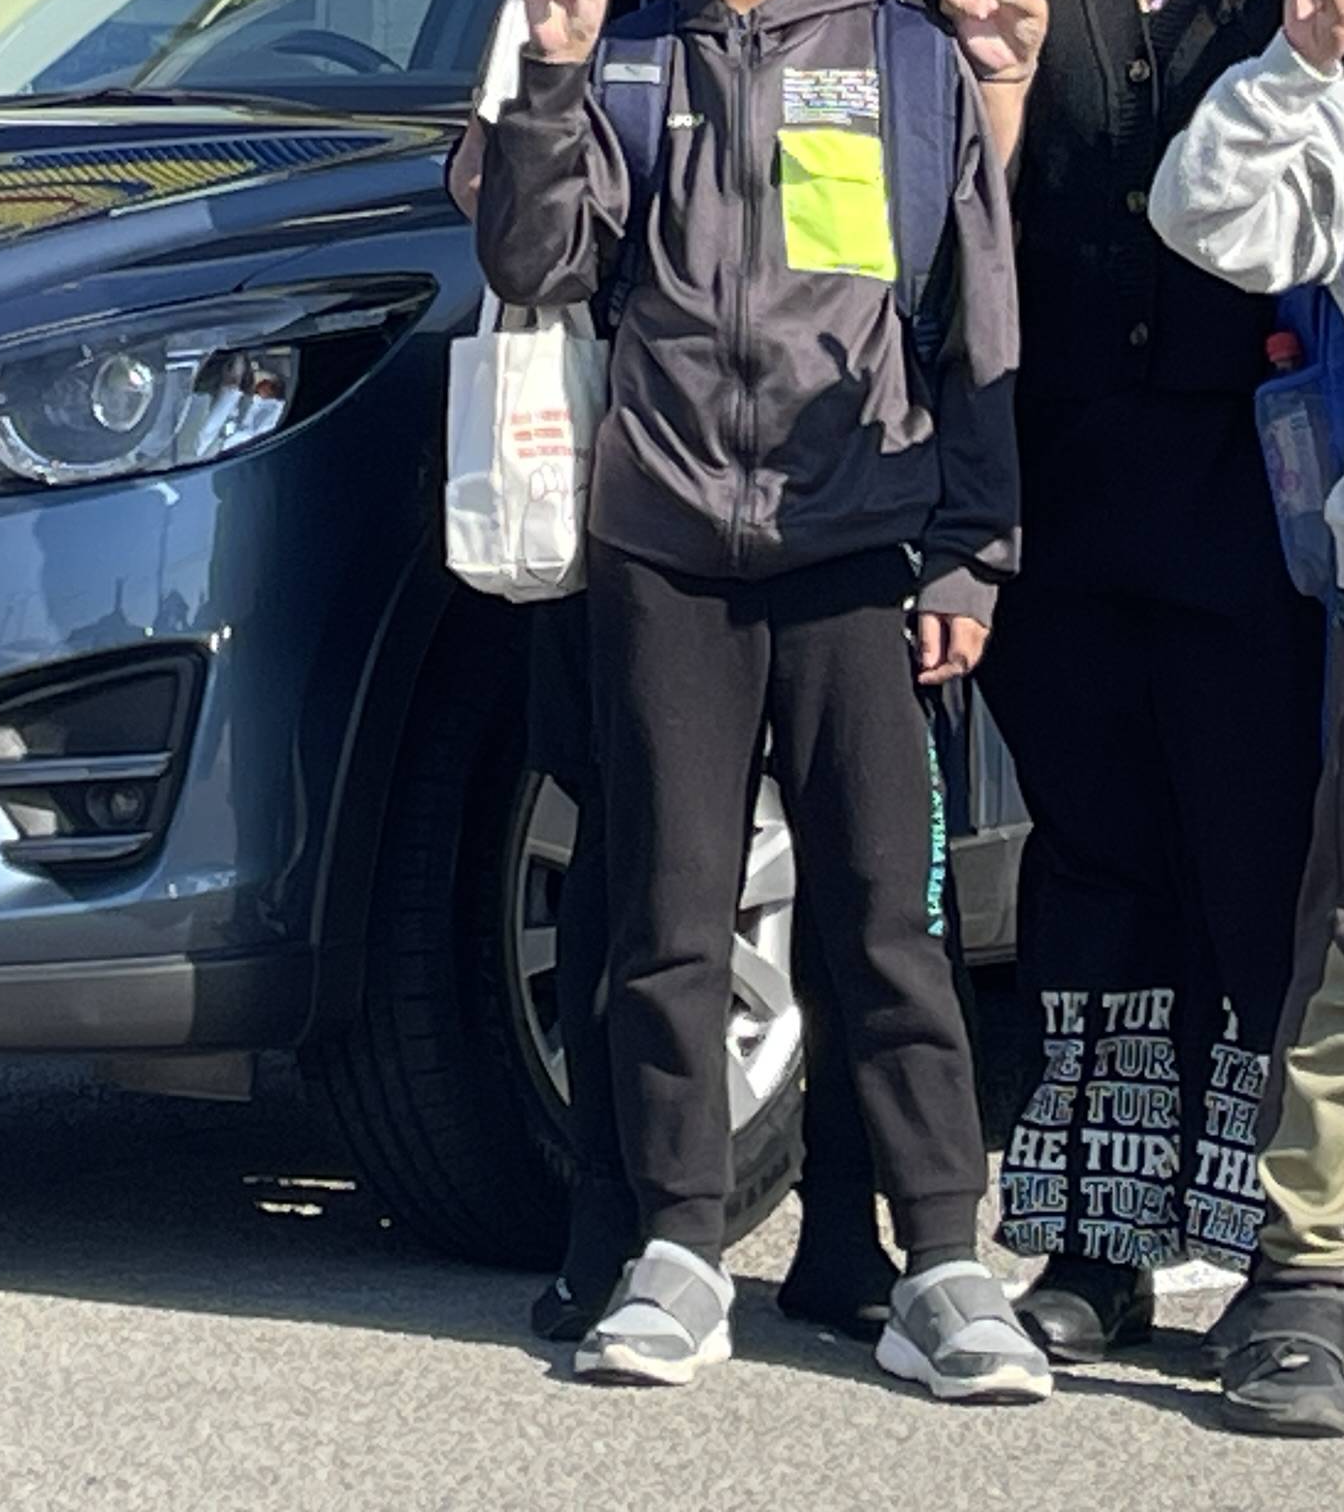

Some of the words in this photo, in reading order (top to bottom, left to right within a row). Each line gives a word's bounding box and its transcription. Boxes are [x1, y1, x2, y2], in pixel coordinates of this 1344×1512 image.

[1102, 988, 1175, 1033] TUR
[1094, 1035, 1180, 1081] TUR
[1085, 1080, 1181, 1129] TUR
